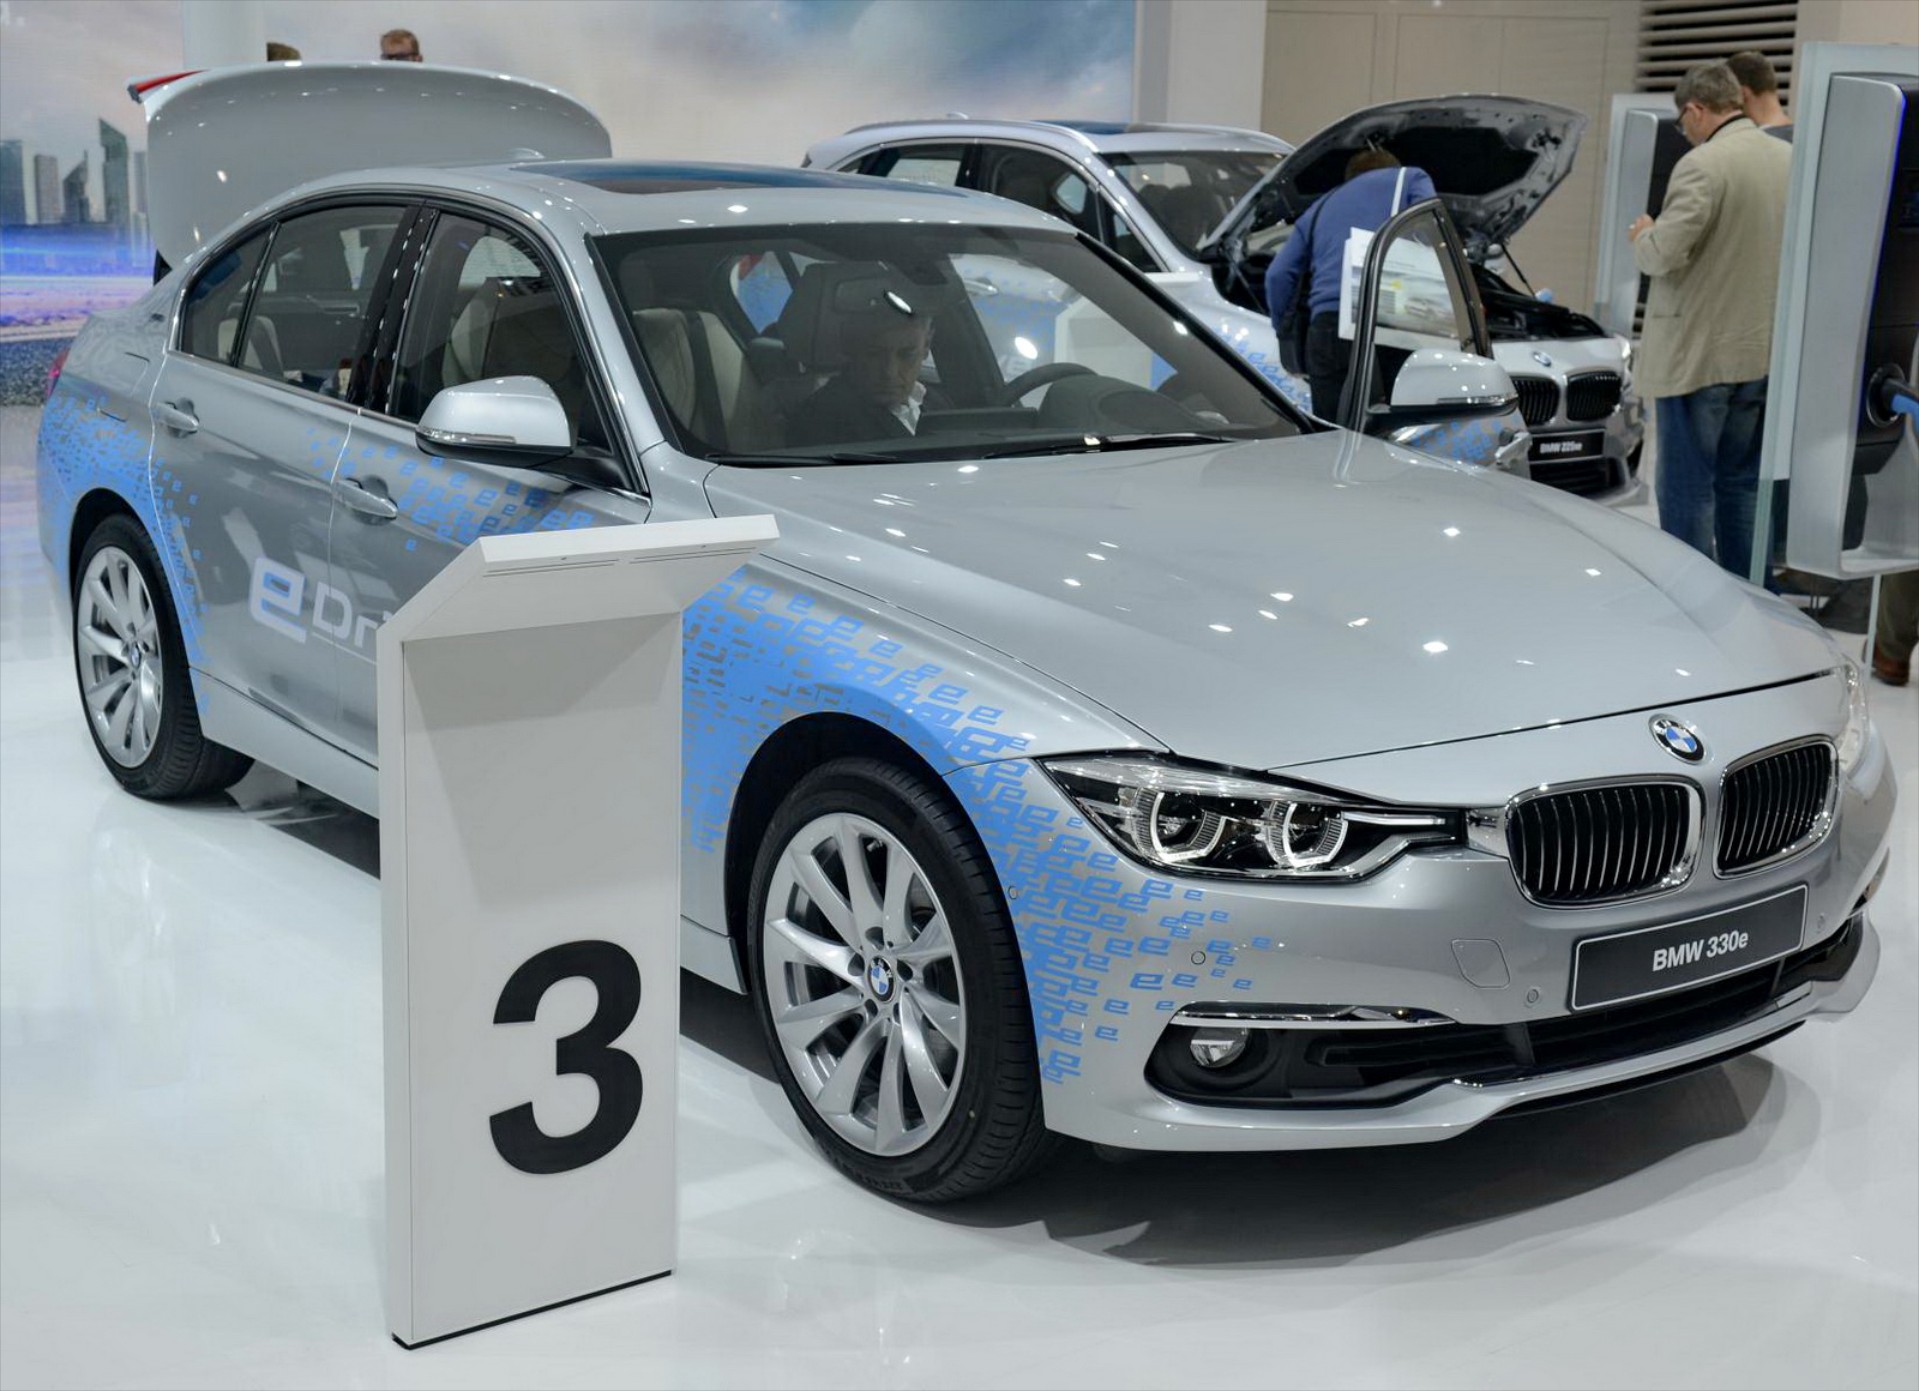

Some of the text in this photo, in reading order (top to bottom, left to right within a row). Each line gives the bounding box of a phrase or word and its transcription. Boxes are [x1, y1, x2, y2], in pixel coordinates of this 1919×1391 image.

[1652, 929, 1749, 972] BMW 330e
[489, 940, 644, 1175] 3
